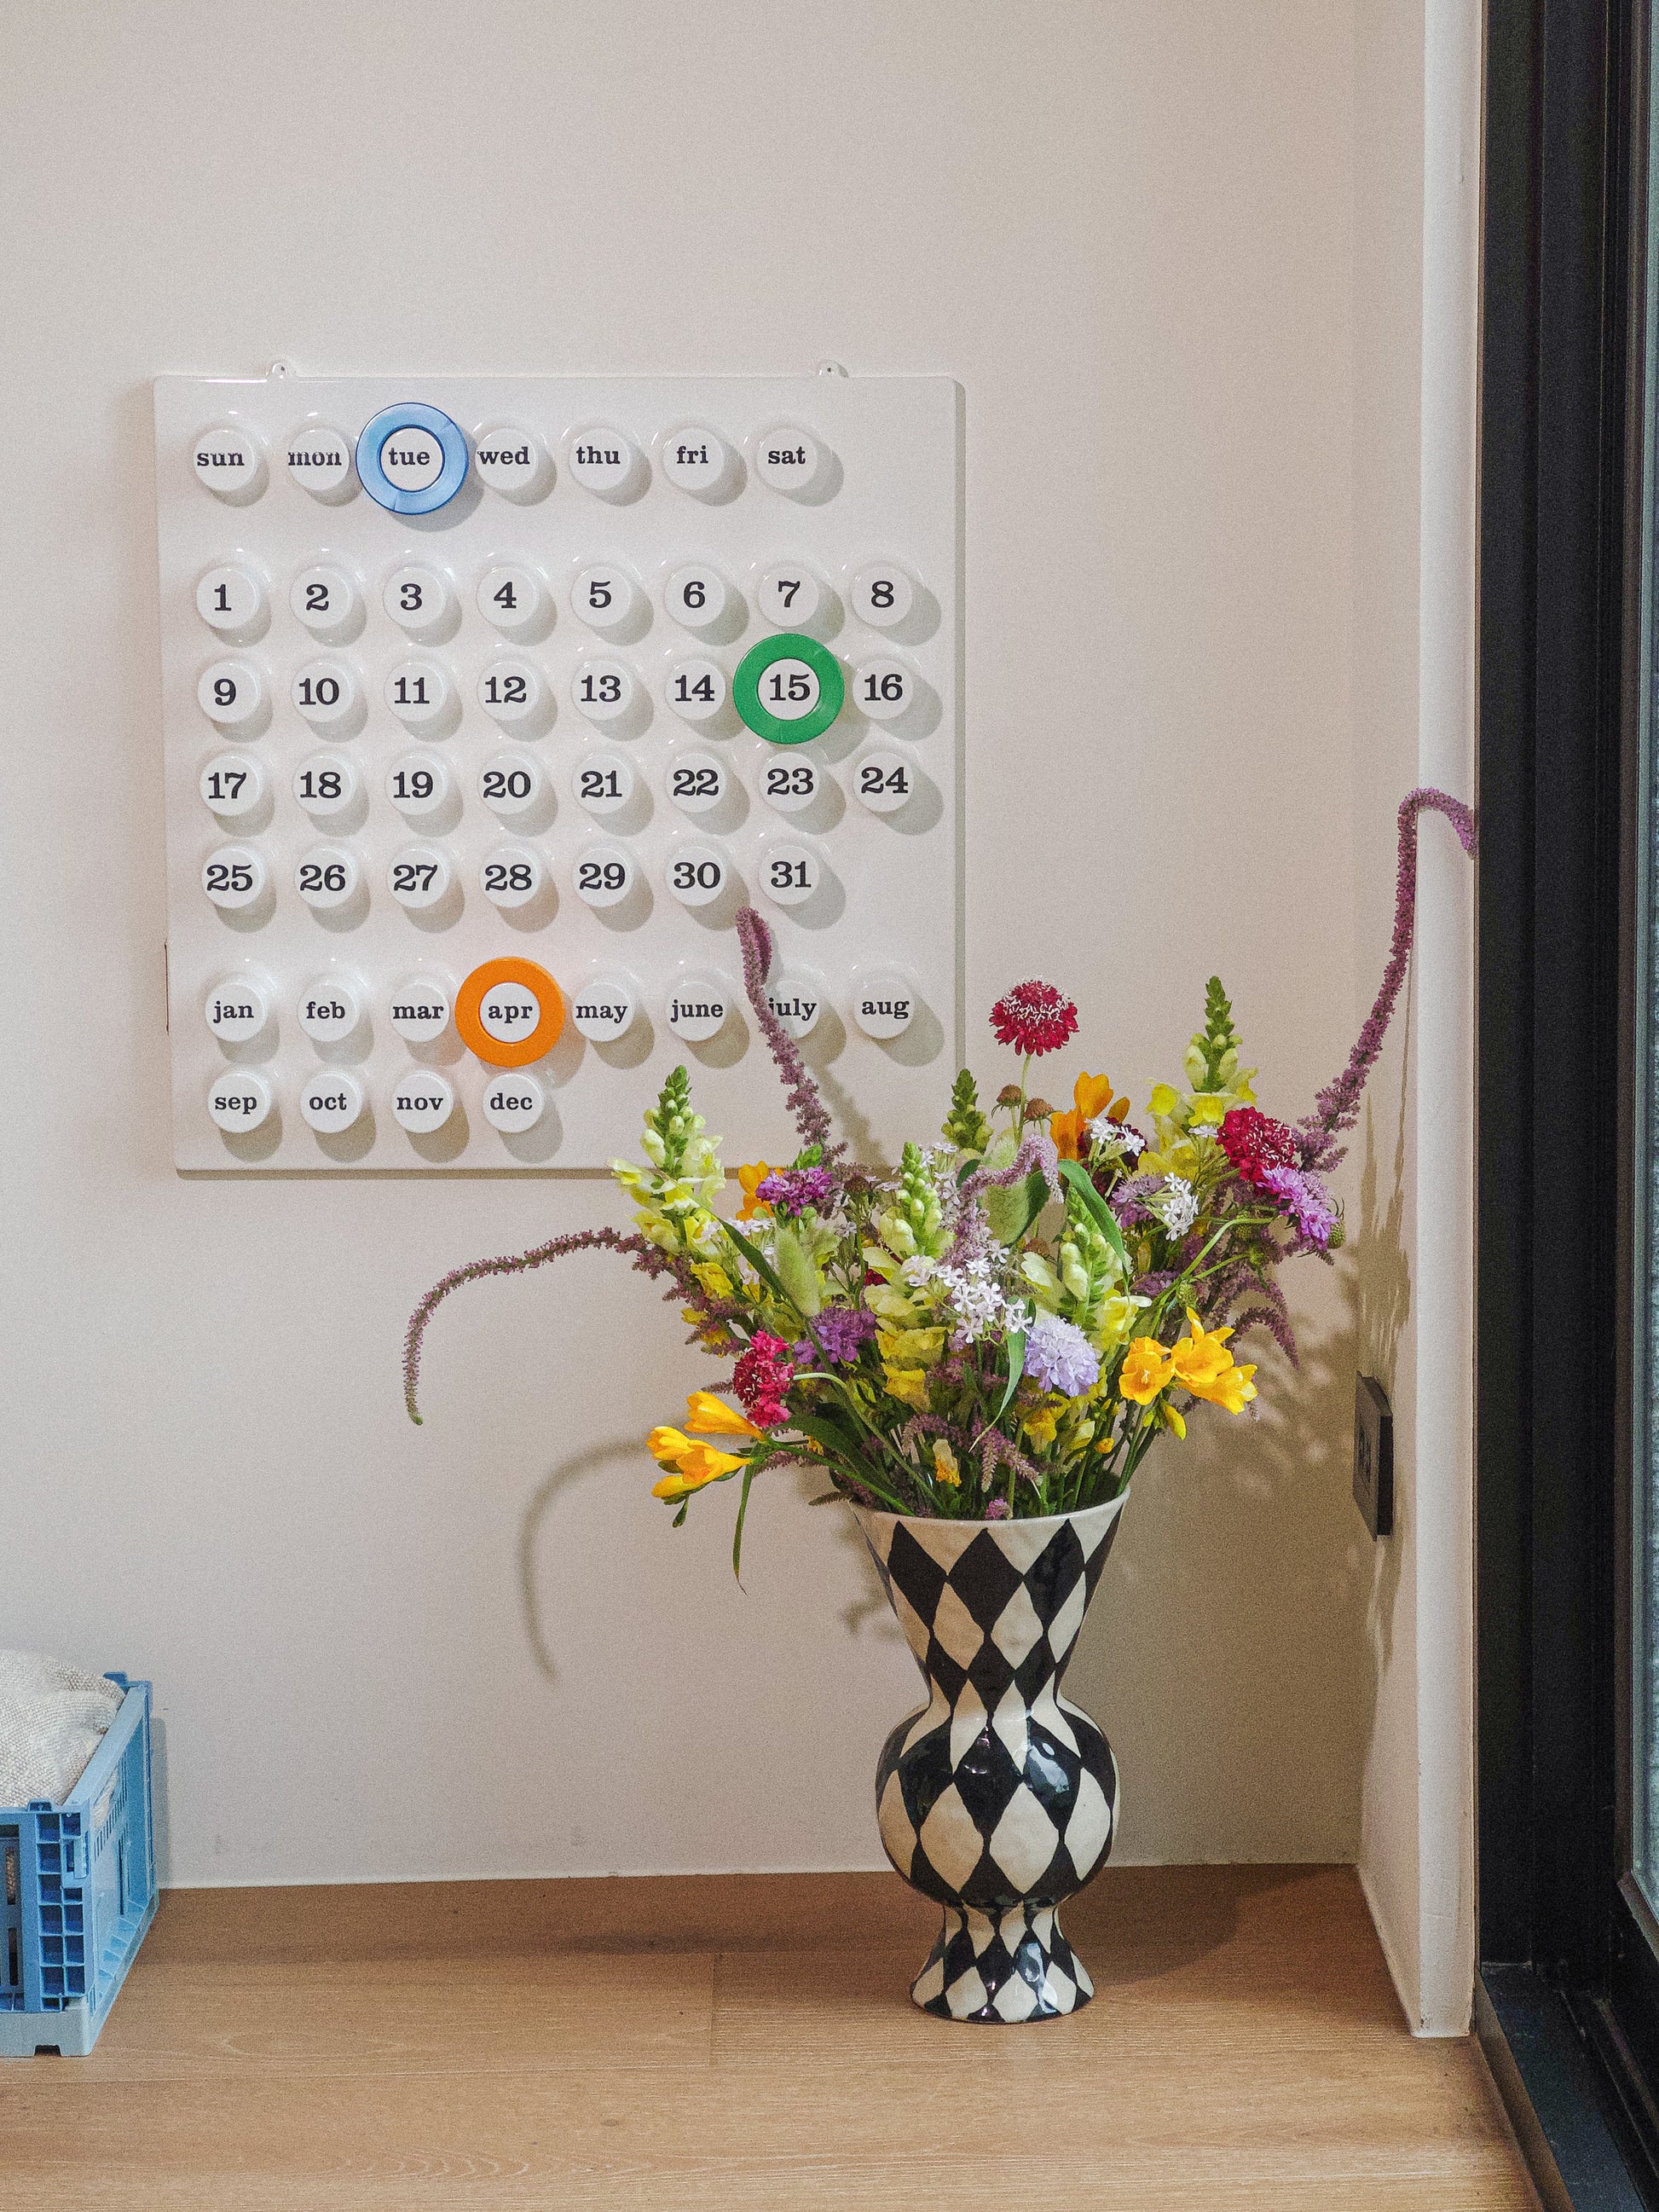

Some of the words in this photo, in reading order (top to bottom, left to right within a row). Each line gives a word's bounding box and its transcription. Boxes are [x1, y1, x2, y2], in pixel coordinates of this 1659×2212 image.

[197, 453, 245, 466] sun
[287, 452, 342, 466] mon
[388, 448, 431, 466] tue
[478, 446, 530, 465] wed
[575, 445, 621, 465] thu
[676, 444, 708, 464] fri
[767, 446, 806, 465] sat
[214, 583, 232, 611] 1
[306, 583, 329, 611] 2
[400, 583, 423, 611] 3
[494, 582, 517, 609] 4
[589, 581, 612, 609] 5
[683, 581, 706, 609] 6
[777, 581, 801, 608] 7
[870, 580, 894, 608] 8
[214, 678, 236, 706] 9
[298, 678, 339, 705] 10
[394, 677, 430, 704] 11
[485, 675, 527, 704] 12
[581, 675, 621, 703] 13
[674, 675, 715, 702] 14
[769, 674, 811, 702] 15
[864, 673, 903, 701] 16
[208, 772, 247, 799] 17
[300, 771, 342, 799] 18
[393, 771, 434, 798] 19
[483, 771, 531, 798] 20
[581, 770, 622, 798] 21
[673, 768, 720, 796] 22
[767, 767, 814, 796] 23
[861, 767, 909, 794] 24
[206, 864, 253, 892] 25
[299, 864, 346, 892] 26
[393, 864, 438, 891] 27
[485, 864, 532, 891] 28
[579, 862, 626, 890] 29
[673, 861, 721, 889] 30
[771, 860, 812, 889] 31
[212, 1000, 254, 1024] jan
[306, 1001, 345, 1020] feb
[392, 1005, 444, 1020] mar
[488, 1005, 533, 1024] apr
[575, 1005, 627, 1024] may
[670, 999, 724, 1023] june
[861, 1000, 910, 1020] aug
[215, 1097, 257, 1115] sep
[309, 1092, 347, 1110] oct
[396, 1097, 444, 1111] nov
[490, 1092, 533, 1110] dec
